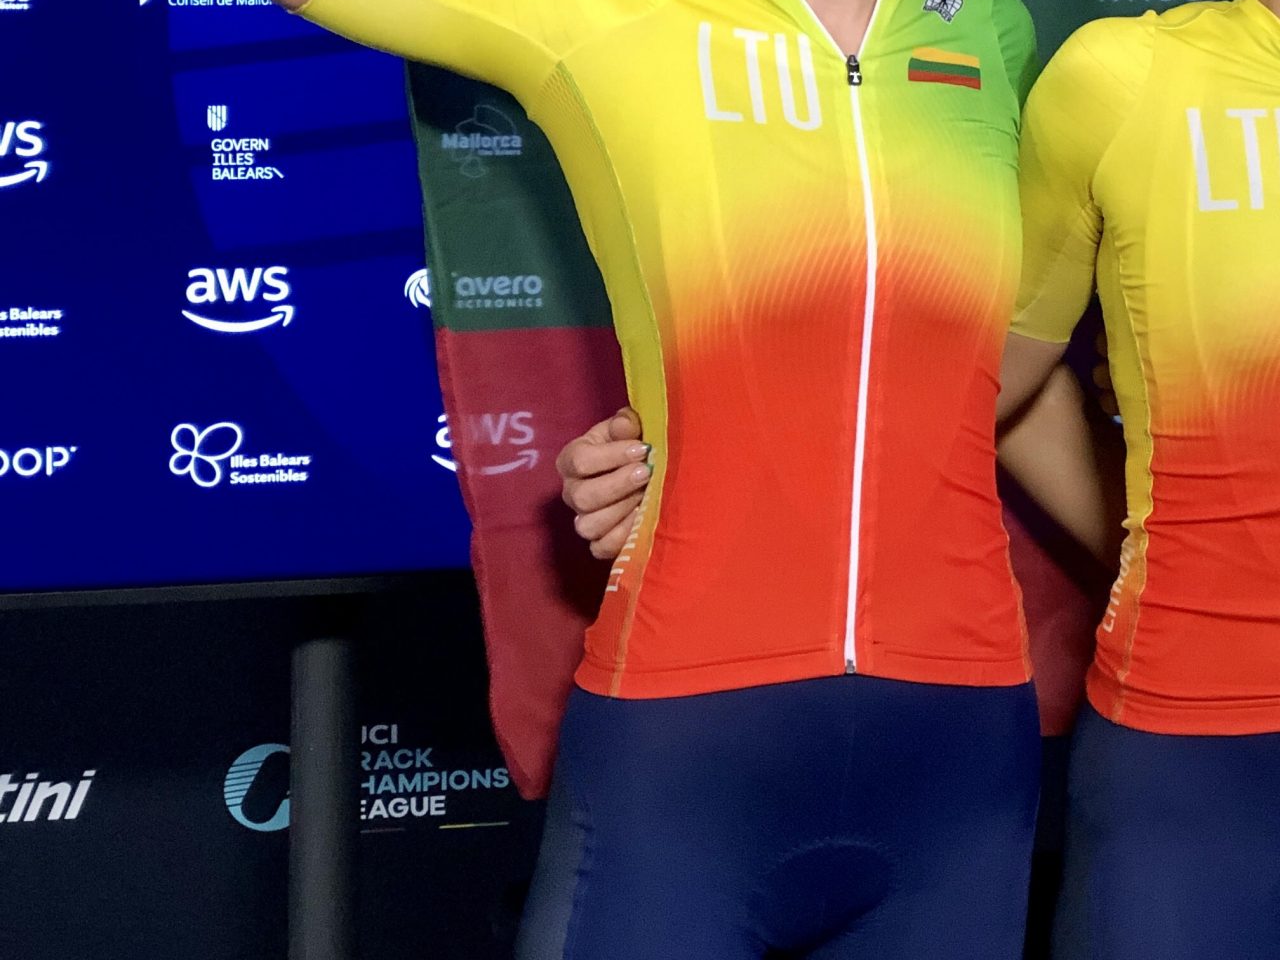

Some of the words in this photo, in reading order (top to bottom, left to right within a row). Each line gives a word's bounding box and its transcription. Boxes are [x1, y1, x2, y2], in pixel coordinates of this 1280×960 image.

[696, 21, 823, 131] LTU
[211, 138, 270, 152] GOVERN
[441, 132, 522, 149] Mallorca
[212, 153, 255, 166] ILLES
[212, 167, 273, 180] BALEARS
[185, 266, 290, 304] aws
[9, 307, 62, 321] Balears
[230, 454, 258, 468] Illes
[260, 453, 310, 467] Balears
[230, 468, 307, 484] Sostenibles
